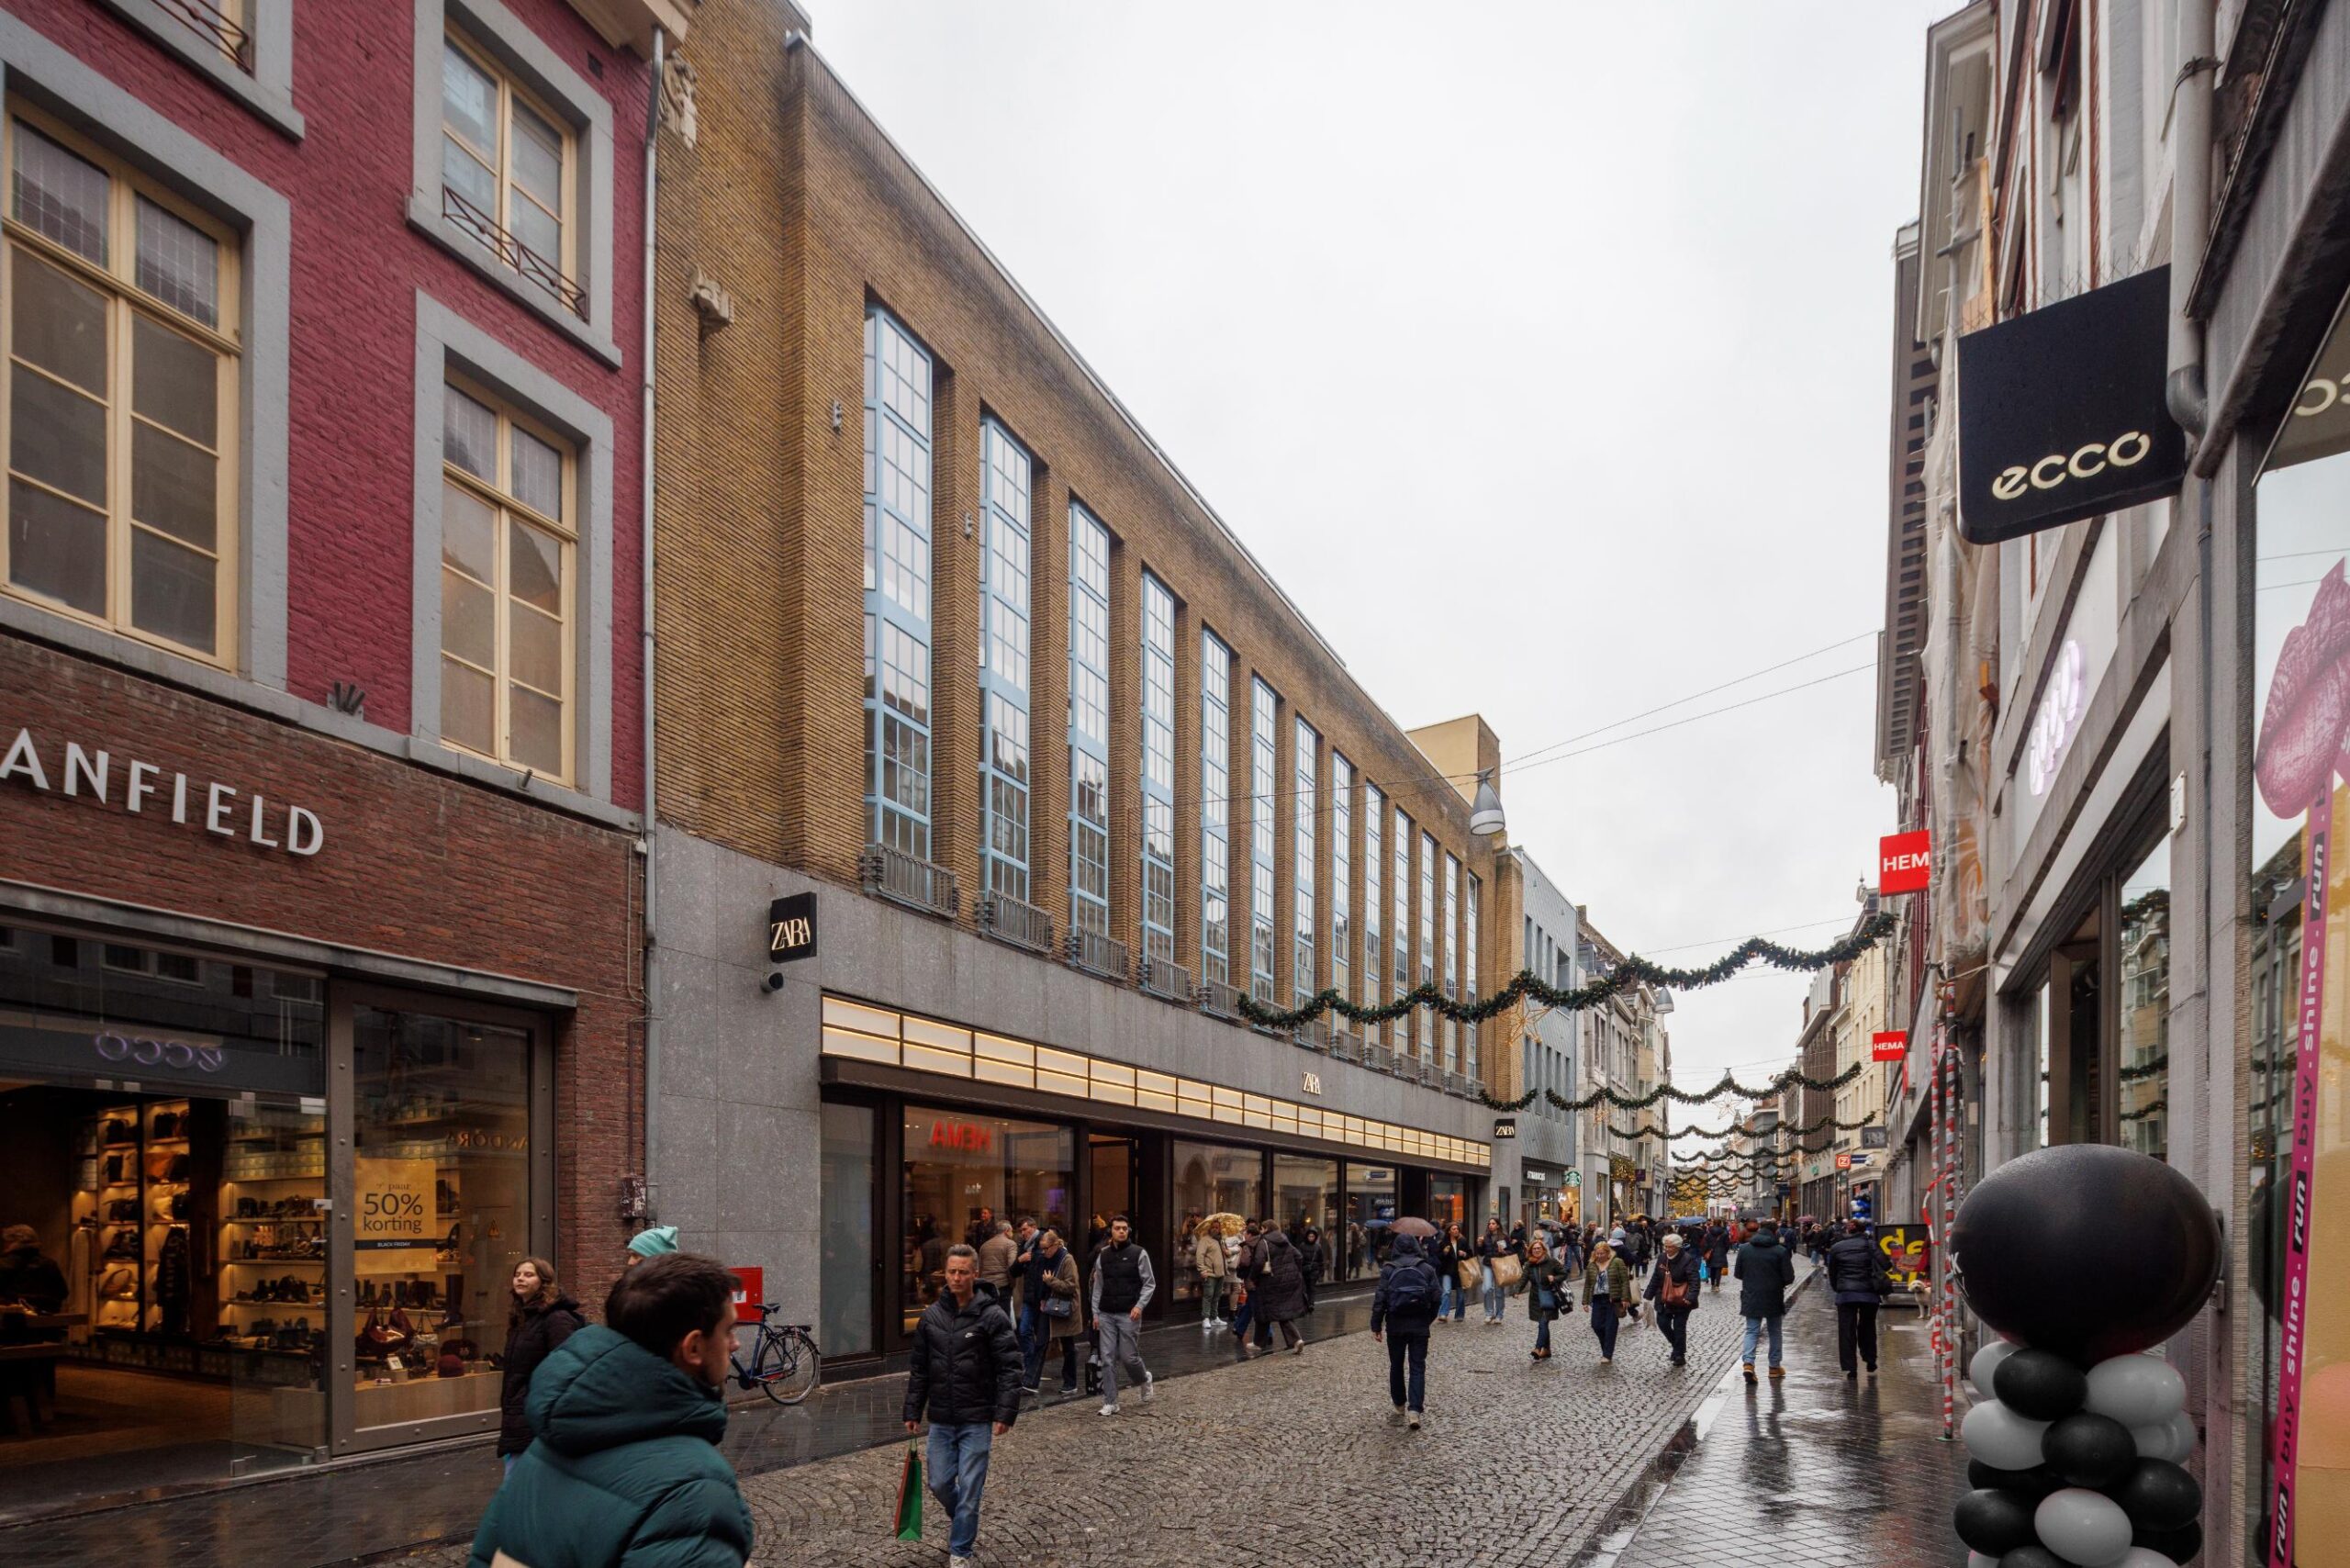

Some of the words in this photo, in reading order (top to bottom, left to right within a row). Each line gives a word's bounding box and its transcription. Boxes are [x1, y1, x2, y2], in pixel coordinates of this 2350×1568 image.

[1992, 431, 2151, 500] ecco
[0, 727, 324, 857] ANFIELD
[1883, 851, 1930, 873] HEM
[2311, 842, 2324, 911] run
[771, 916, 811, 951] ZARA
[2303, 946, 2319, 1052] shine
[1874, 1041, 1905, 1051] HEMA
[1303, 1071, 1321, 1094] ZARA
[2298, 1075, 2313, 1147] buy
[1495, 1126, 1515, 1136] ZARA
[364, 1193, 423, 1215] 50%
[364, 1216, 422, 1235] korting
[2293, 1179, 2306, 1246] run
[2286, 1276, 2300, 1376] shine
[2280, 1395, 2295, 1464] buy
[2276, 1492, 2288, 1558] run
